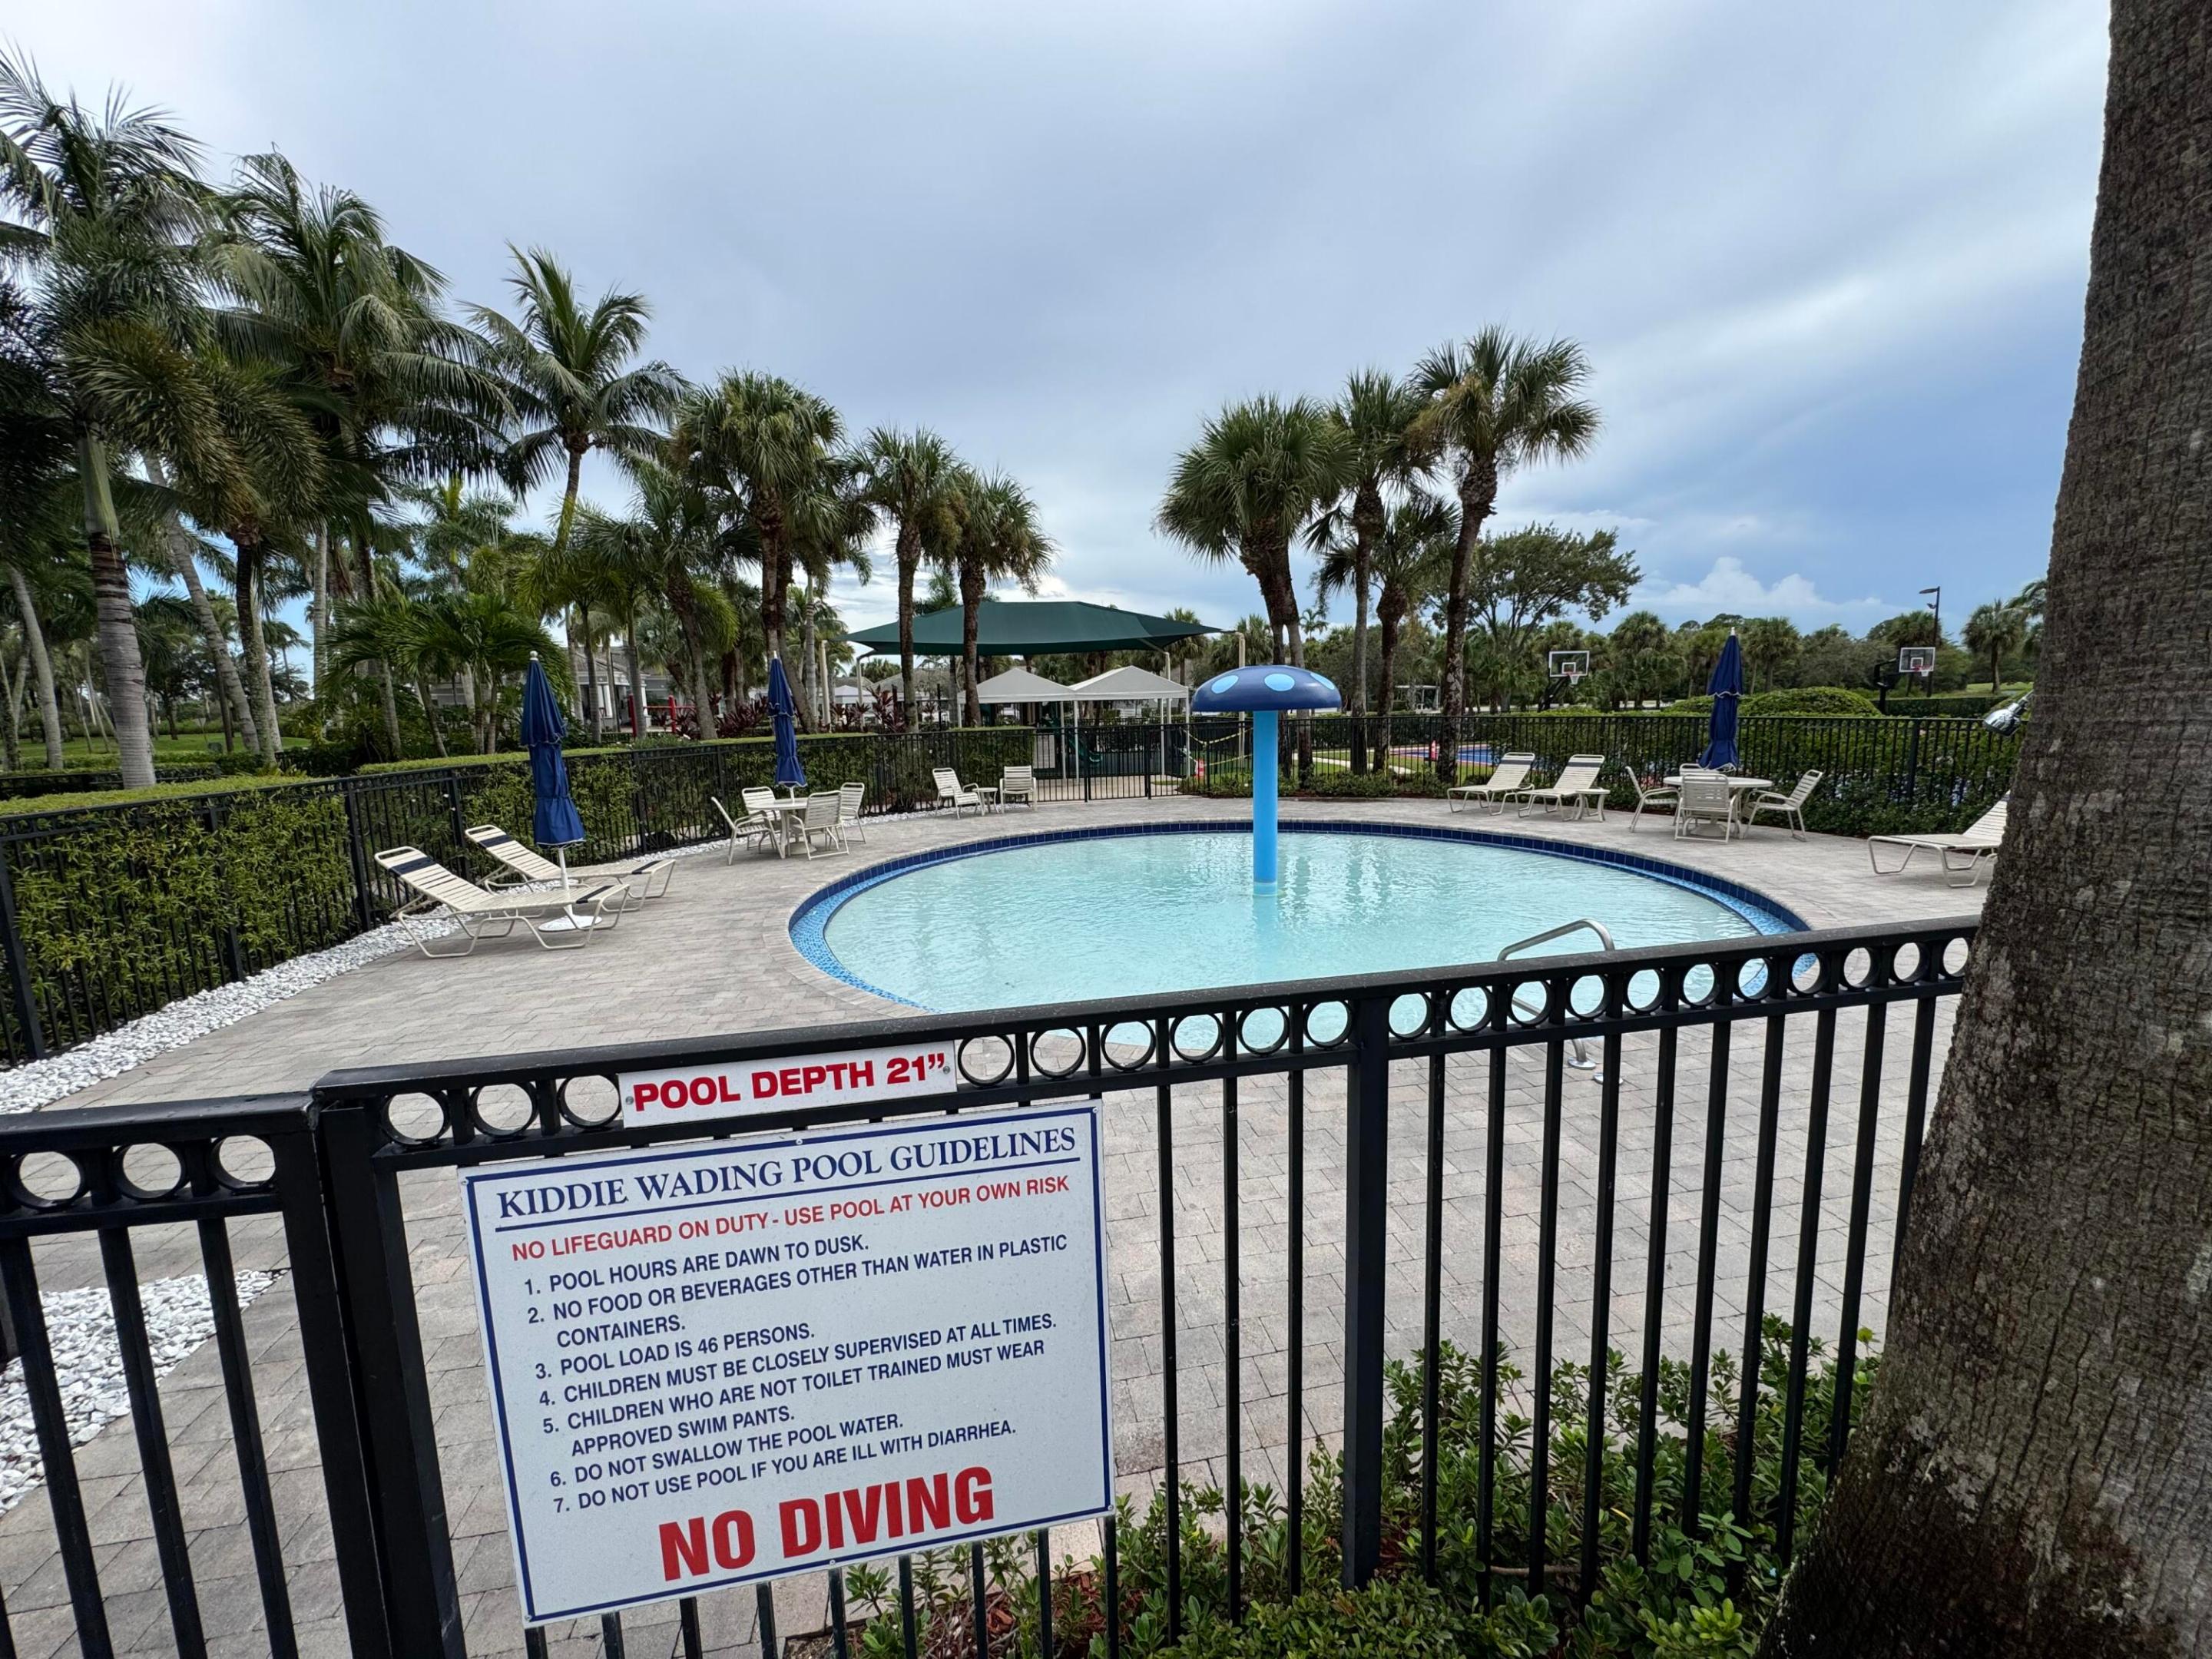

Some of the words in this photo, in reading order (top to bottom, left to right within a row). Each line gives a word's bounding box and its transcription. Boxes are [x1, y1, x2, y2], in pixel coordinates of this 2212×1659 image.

[634, 1075, 740, 1112] POOL
[751, 1061, 874, 1098] DEPTH
[498, 1178, 628, 1218] KIDDIE
[634, 1161, 782, 1200] WADING
[791, 1150, 882, 1183] POOL
[890, 1127, 1075, 1171] GUIDELINES
[512, 1240, 545, 1260] NO
[551, 1225, 671, 1255] LIFEGUARD
[678, 1220, 708, 1239] ON
[716, 1212, 767, 1234] DUTY
[785, 1206, 823, 1225] USE
[830, 1199, 884, 1220] POOL
[890, 1194, 912, 1212] AT
[918, 1187, 970, 1208] YOUR
[976, 1181, 1020, 1201] OWN
[1027, 1175, 1068, 1195] RISK
[525, 1279, 540, 1295] 1.
[549, 1270, 604, 1292] POOL
[609, 1259, 677, 1283] HOURS
[683, 1253, 720, 1273] ARE
[725, 1245, 780, 1267] DAWN
[784, 1241, 809, 1259] TO
[815, 1234, 868, 1256] DUSK.
[528, 1307, 544, 1323] 2.
[553, 1300, 581, 1320] NO
[588, 1292, 642, 1315] FOOD
[648, 1287, 675, 1306] OR
[681, 1271, 791, 1301] BEVERAGES
[796, 1263, 856, 1285] OTHER
[861, 1255, 909, 1276] THAN
[913, 1247, 972, 1269] WATER
[978, 1243, 993, 1260] IN
[999, 1234, 1067, 1257] PLASTIC
[535, 1363, 551, 1379] 3.
[561, 1353, 614, 1375] POOL
[619, 1344, 669, 1366] LOAD
[675, 1340, 692, 1357] IS
[697, 1337, 718, 1353] 46
[724, 1323, 814, 1350] PERSONS.
[539, 1390, 555, 1406] 4.
[564, 1373, 661, 1402] CHILDREN
[666, 1363, 717, 1386] MUST
[723, 1359, 747, 1377] BE
[752, 1346, 829, 1373] CLOSELY
[834, 1330, 941, 1360] SUPERVISED
[946, 1326, 966, 1343] AT
[970, 1321, 1001, 1339] ALL
[1002, 1313, 1056, 1334] TIMES.
[557, 1314, 685, 1347] CONTAINERS.
[543, 1417, 558, 1433] 5.
[568, 1399, 664, 1429] CHILDREN
[668, 1391, 713, 1412] WHO
[719, 1384, 755, 1405] ARE
[760, 1377, 796, 1398] NOT
[802, 1367, 862, 1391] TOILET
[867, 1356, 941, 1380] TRAINED
[946, 1347, 992, 1369] MUST
[996, 1339, 1044, 1360] WEAR
[550, 1471, 566, 1487] 6.
[575, 1463, 602, 1482] DO
[608, 1455, 646, 1477] NOT
[652, 1439, 742, 1469] SWALLOW
[747, 1432, 783, 1452] THE
[787, 1424, 836, 1446] POOL
[839, 1413, 902, 1436] WATER.
[553, 1497, 569, 1512] 7.
[578, 1490, 605, 1508] DO
[611, 1482, 649, 1503] NOT
[655, 1474, 692, 1495] USE
[697, 1465, 747, 1488] POOL
[751, 1461, 766, 1478] IF
[771, 1454, 807, 1474] YOU
[813, 1447, 847, 1468] ARE
[853, 1443, 877, 1460] ILL
[880, 1434, 922, 1455] WITH
[928, 1419, 1015, 1447] DIARRHEA.
[571, 1425, 672, 1456] APPROVED
[677, 1416, 727, 1438] SWIM
[733, 1406, 794, 1429] PANTS.
[659, 1510, 755, 1581] NO
[779, 1466, 993, 1558] DIVING
